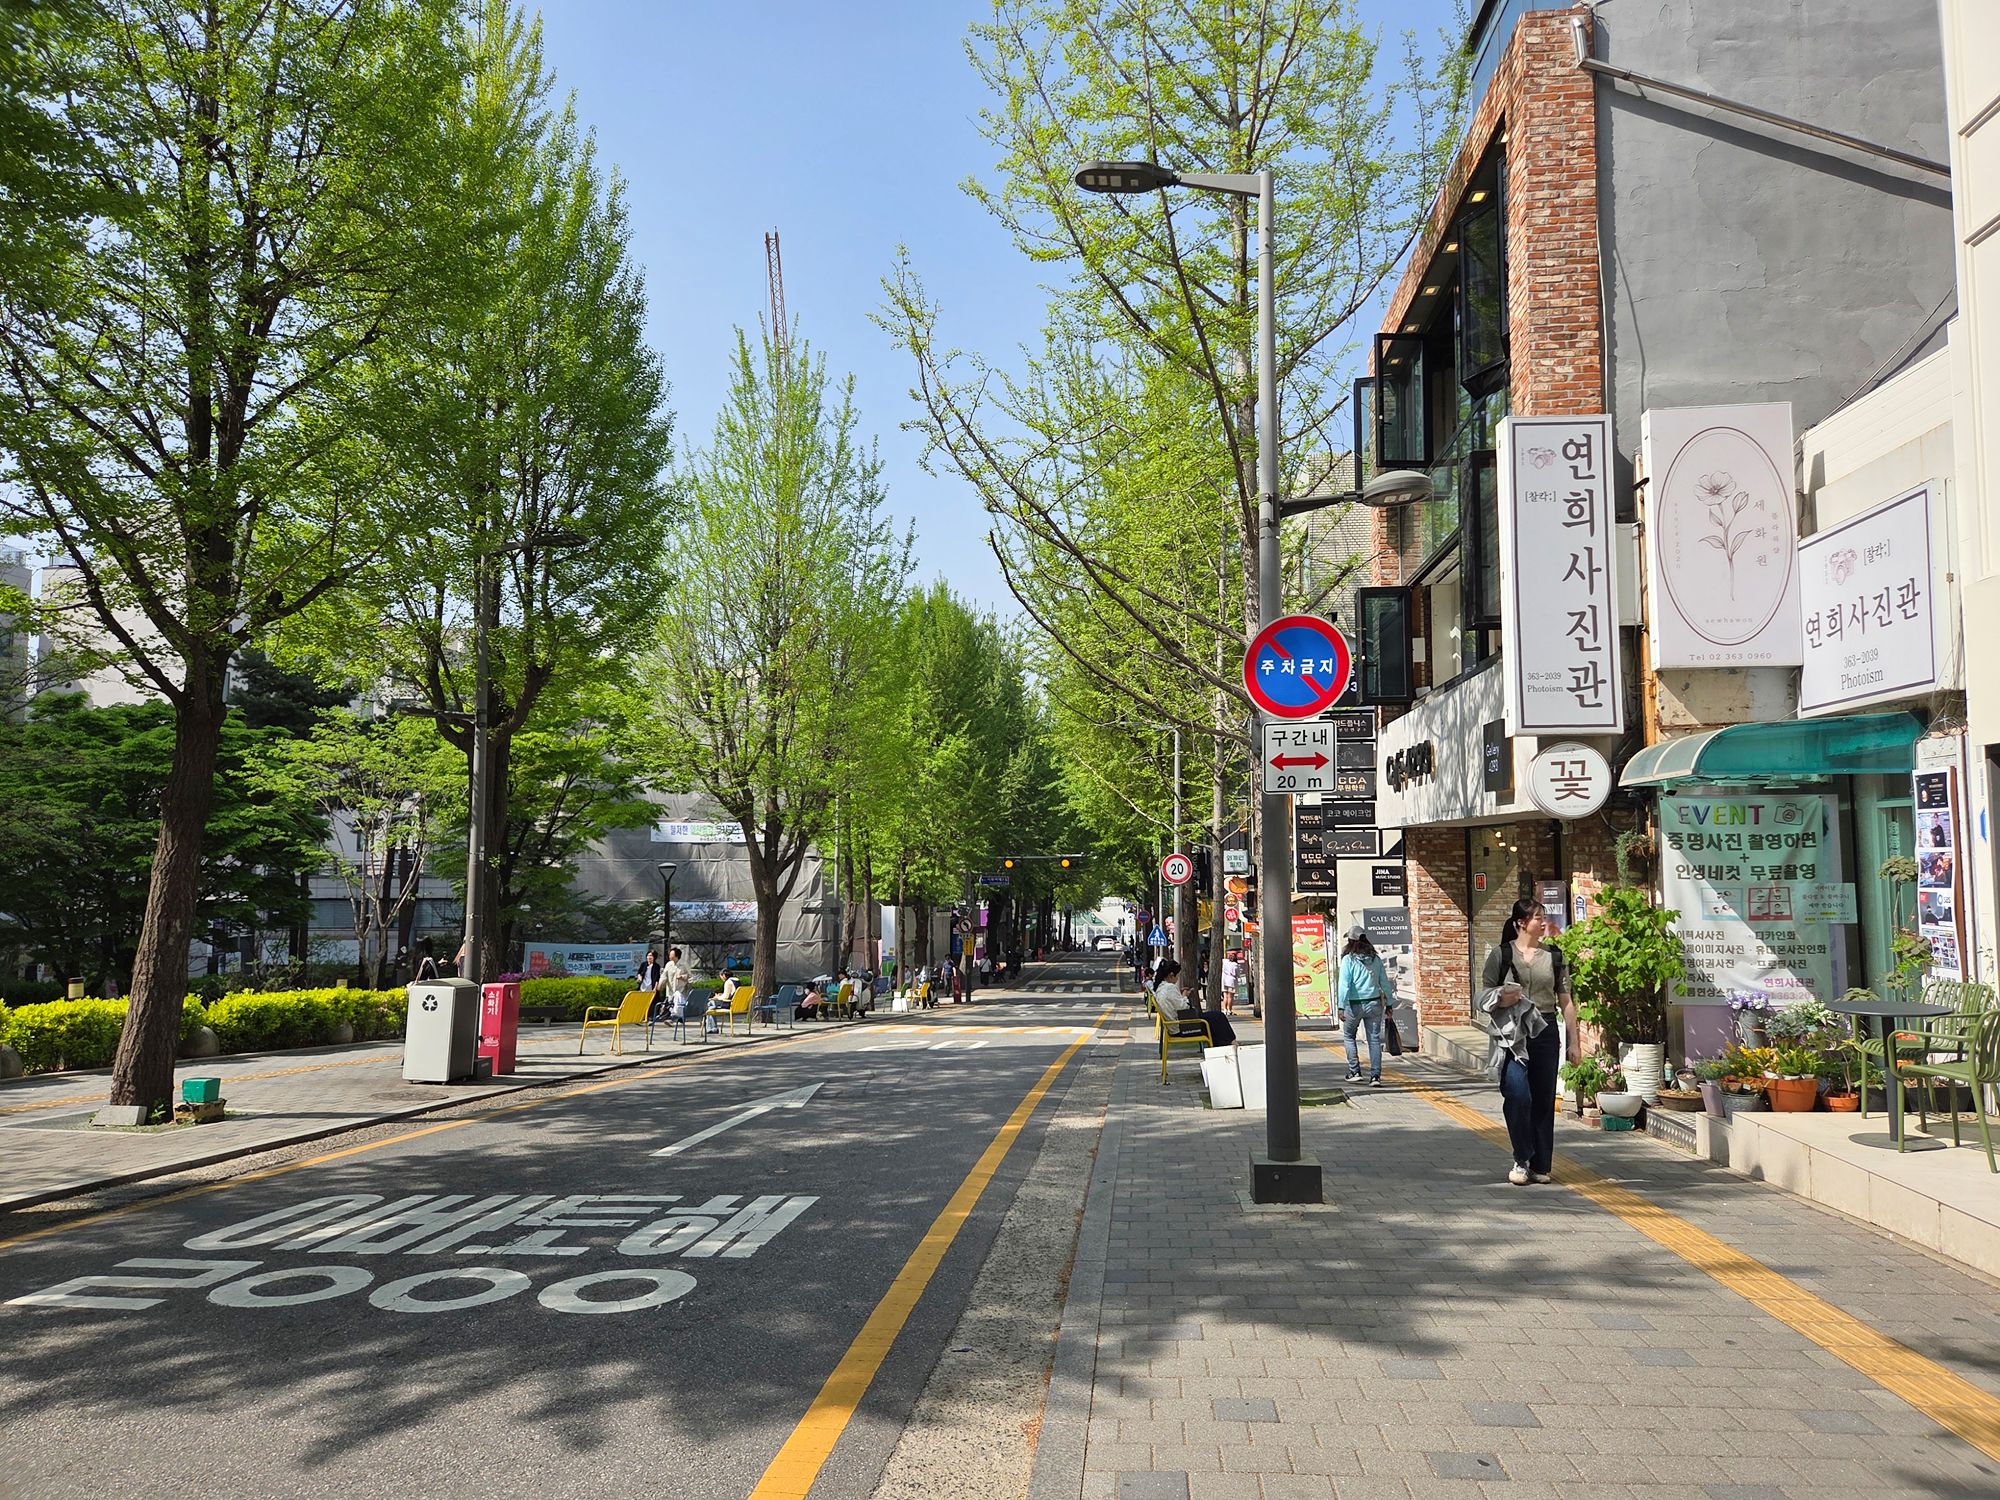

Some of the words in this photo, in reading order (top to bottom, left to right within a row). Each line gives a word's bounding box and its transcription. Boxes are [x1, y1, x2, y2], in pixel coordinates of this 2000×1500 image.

[1753, 499, 1768, 567] 세화원
[1562, 433, 1607, 708] 연희사진관
[1805, 577, 1921, 650] 연희사진관
[1689, 653, 1705, 661] Tel
[1725, 652, 1744, 661] 363
[1747, 651, 1772, 660] 0960
[1843, 647, 1879, 670] 363-2039
[1260, 657, 1333, 675] 주차금지
[1527, 671, 1562, 682] 363-2039
[1841, 667, 1884, 691] Photoism
[1527, 684, 1563, 693] Photoism
[1271, 728, 1328, 747] 구간내
[1276, 775, 1297, 789] 20
[1307, 779, 1322, 788] m
[1550, 760, 1592, 801] 꽃
[1326, 809, 1341, 817] 코코
[1678, 804, 1765, 825] EVENT
[1667, 831, 1743, 852] 증명사진
[1747, 831, 1817, 850] 촬영하면
[1171, 862, 1184, 876] 20
[1675, 864, 1741, 881] 인생네컷
[1750, 863, 1816, 881] 무료촬영
[1370, 915, 1388, 923] CAFE
[1755, 930, 1796, 941] 디카인화
[1755, 944, 1827, 955] 휴대폰사진인화
[1764, 977, 1815, 988] 연희사진관
[487, 991, 496, 1015] 소화기
